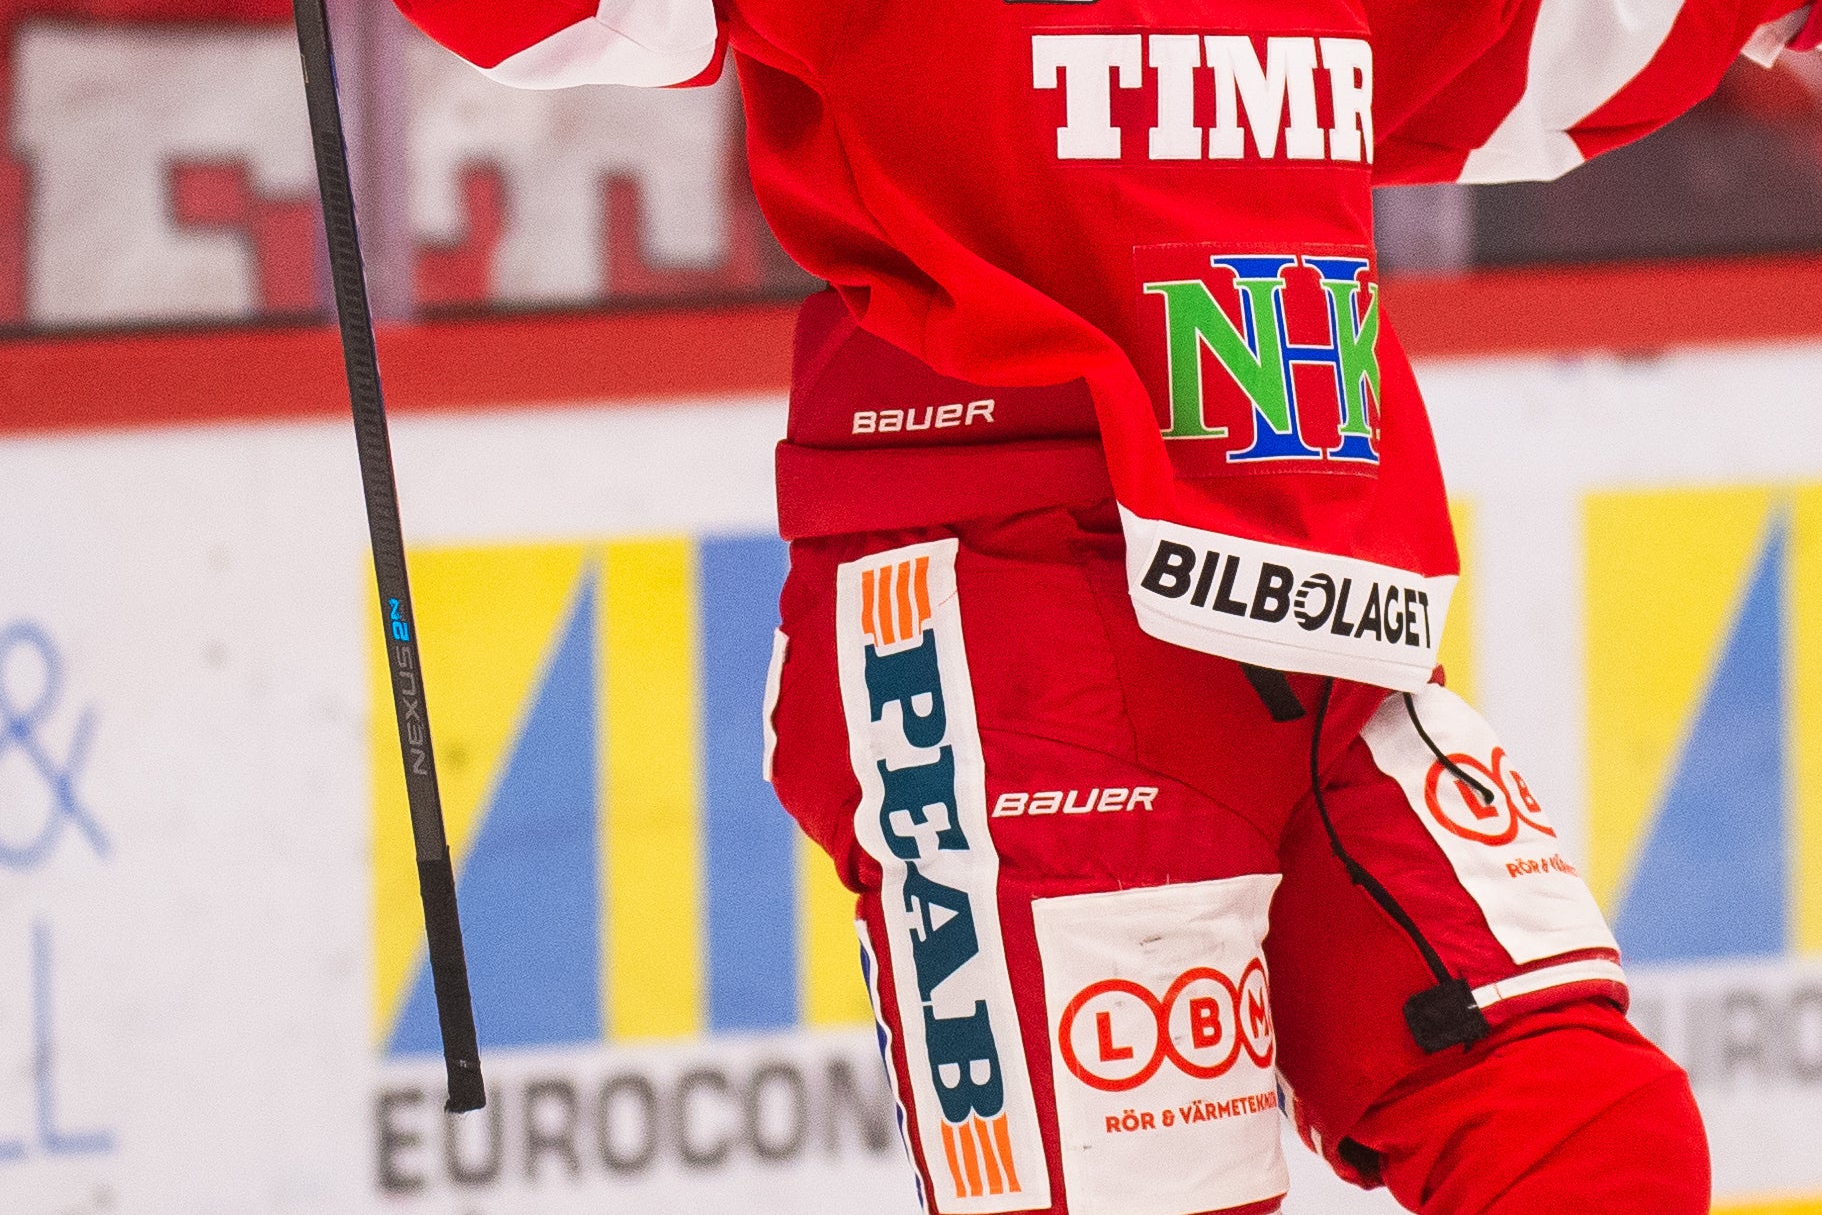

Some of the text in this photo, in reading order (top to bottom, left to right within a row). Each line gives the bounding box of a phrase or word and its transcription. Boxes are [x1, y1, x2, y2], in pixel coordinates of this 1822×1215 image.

[852, 399, 995, 435] BAUER
[1140, 540, 1431, 649] BILBOLAGET
[397, 646, 427, 775] NEXUS
[991, 786, 1159, 819] BAUER
[864, 628, 1005, 1123] PEAB
[374, 1053, 897, 1195] EUROCON
[1105, 1109, 1156, 1133] RÖR
